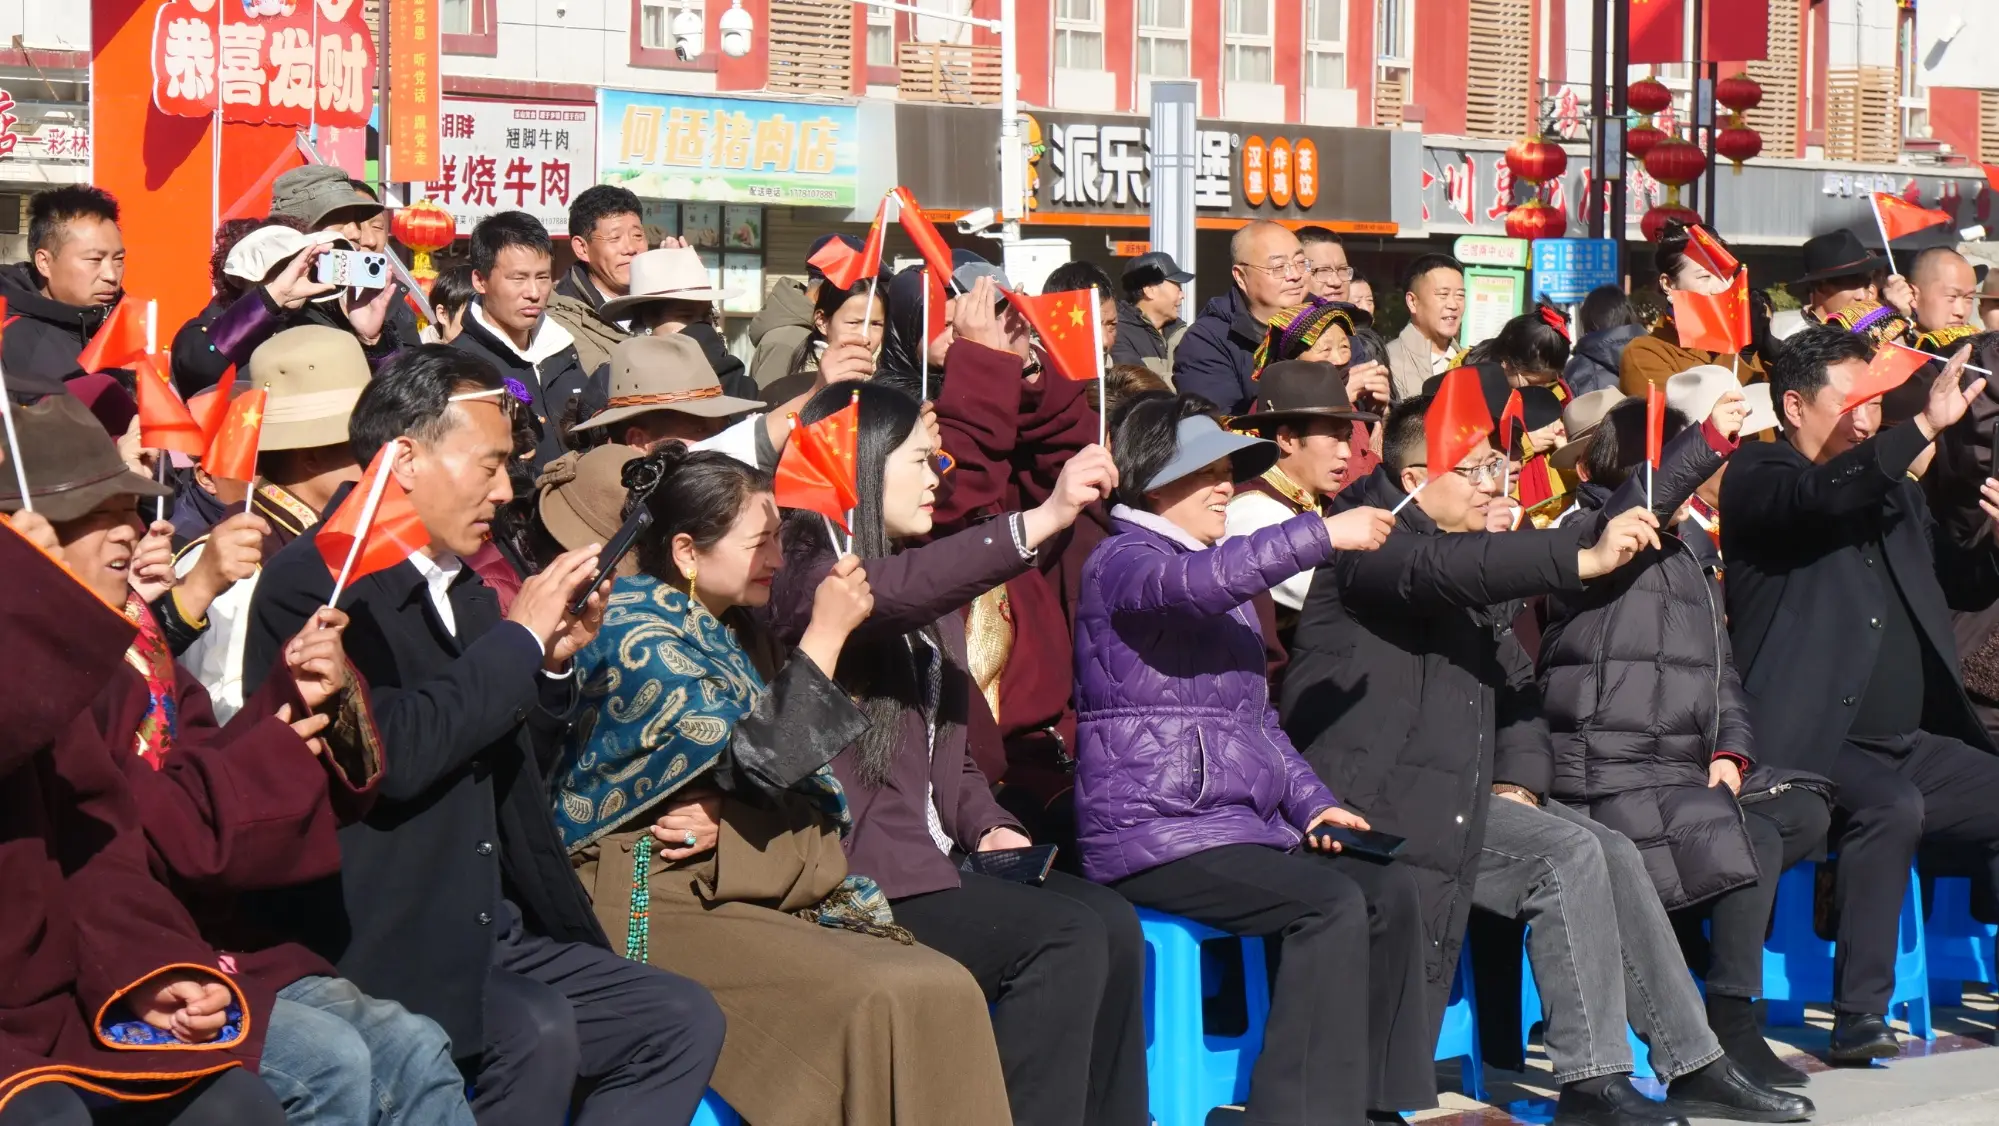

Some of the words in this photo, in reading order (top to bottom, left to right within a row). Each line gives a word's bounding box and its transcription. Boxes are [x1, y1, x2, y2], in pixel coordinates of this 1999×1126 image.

[414, 0, 426, 41] 党恩
[164, 17, 368, 113] 恭喜发财
[413, 53, 427, 103] 听党话
[413, 114, 428, 167] 跟党走
[506, 127, 570, 151] 翘脚牛肉
[618, 104, 840, 175] 何适猪肉店
[424, 154, 572, 209] 鲜烧牛肉
[1051, 124, 1232, 207] 派乐堡
[1247, 145, 1264, 195] 汉堡
[1272, 146, 1289, 196] 炸鸡
[749, 186, 781, 198] 配送电话
